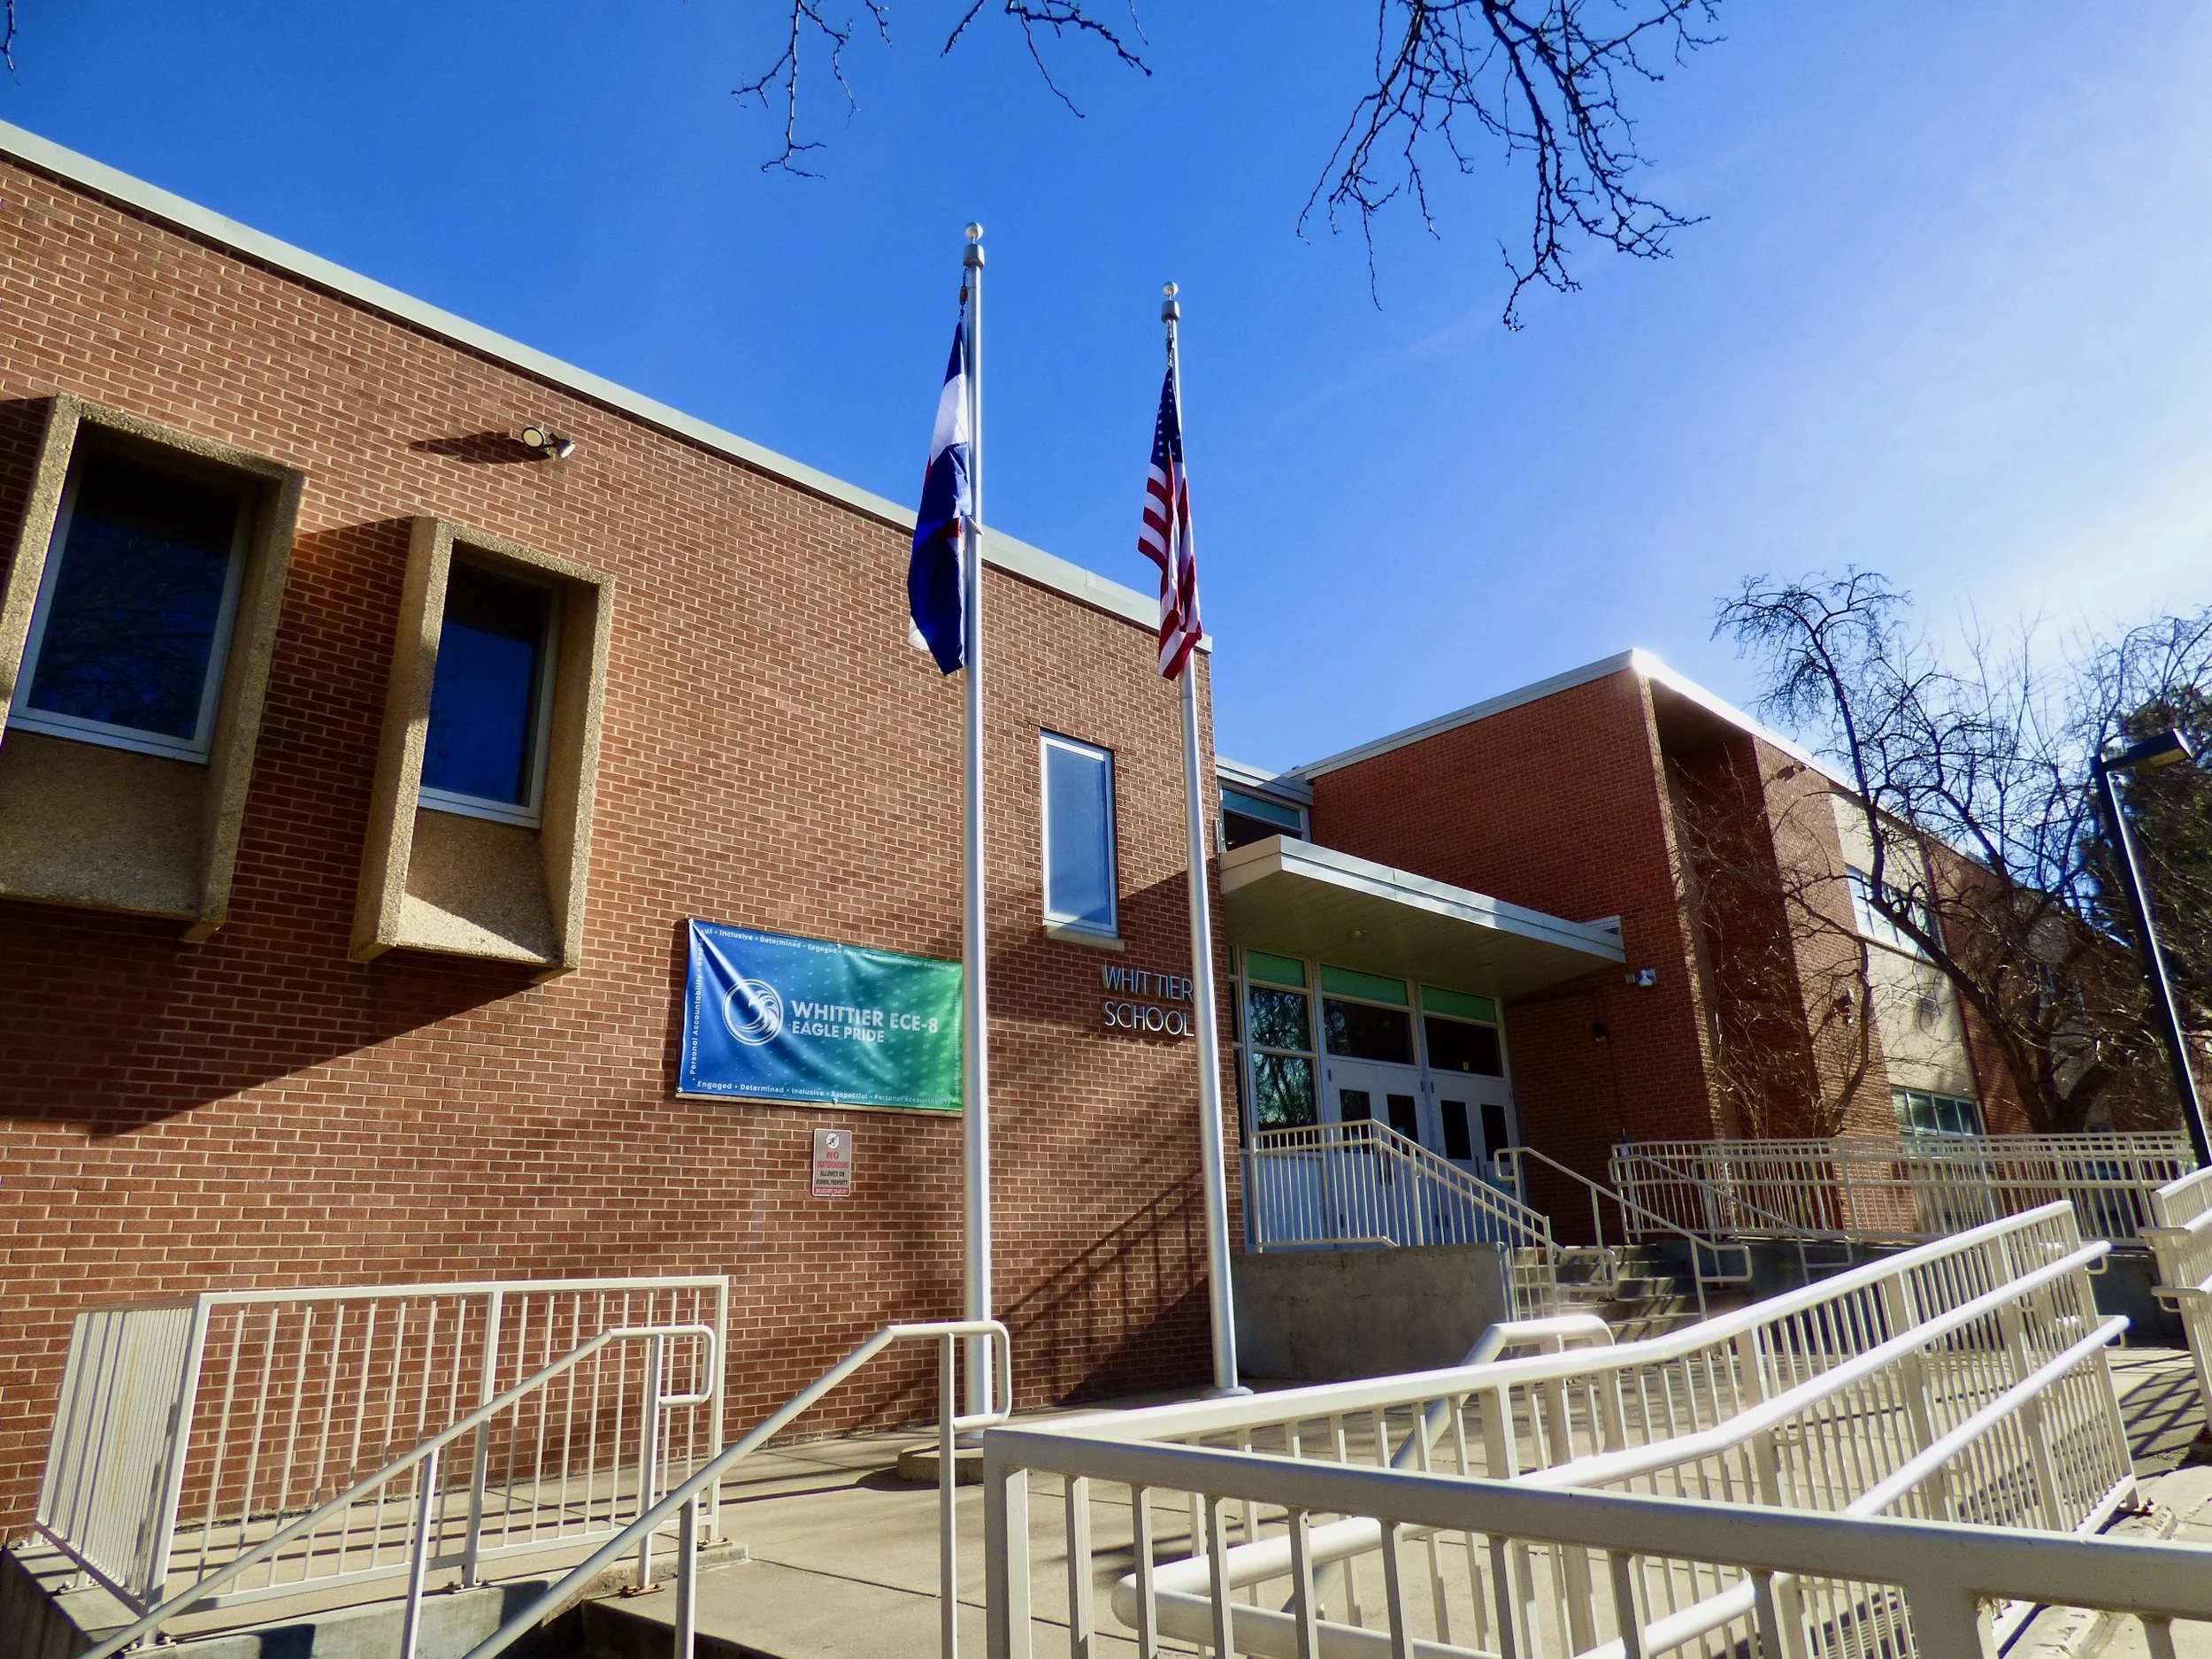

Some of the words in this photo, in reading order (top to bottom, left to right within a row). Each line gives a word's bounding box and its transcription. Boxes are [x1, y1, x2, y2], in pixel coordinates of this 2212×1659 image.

[719, 930, 753, 941] Inclusive
[760, 936, 802, 949] Determined
[808, 943, 837, 954] Engaged
[1103, 964, 1194, 1002] WHITTIER
[692, 974, 703, 1034] Accountability
[790, 1000, 884, 1028] WHITTIER
[889, 1012, 939, 1034] ECE-8
[1104, 1001, 1194, 1037] SCHOOL
[792, 1020, 839, 1039] EAGLE
[843, 1026, 885, 1044] PRIDE
[689, 1038, 698, 1075] Personal
[697, 1080, 733, 1090] Engaged
[740, 1084, 785, 1094] Determined
[791, 1087, 825, 1096] Inclusive
[831, 1091, 868, 1100] Respectful
